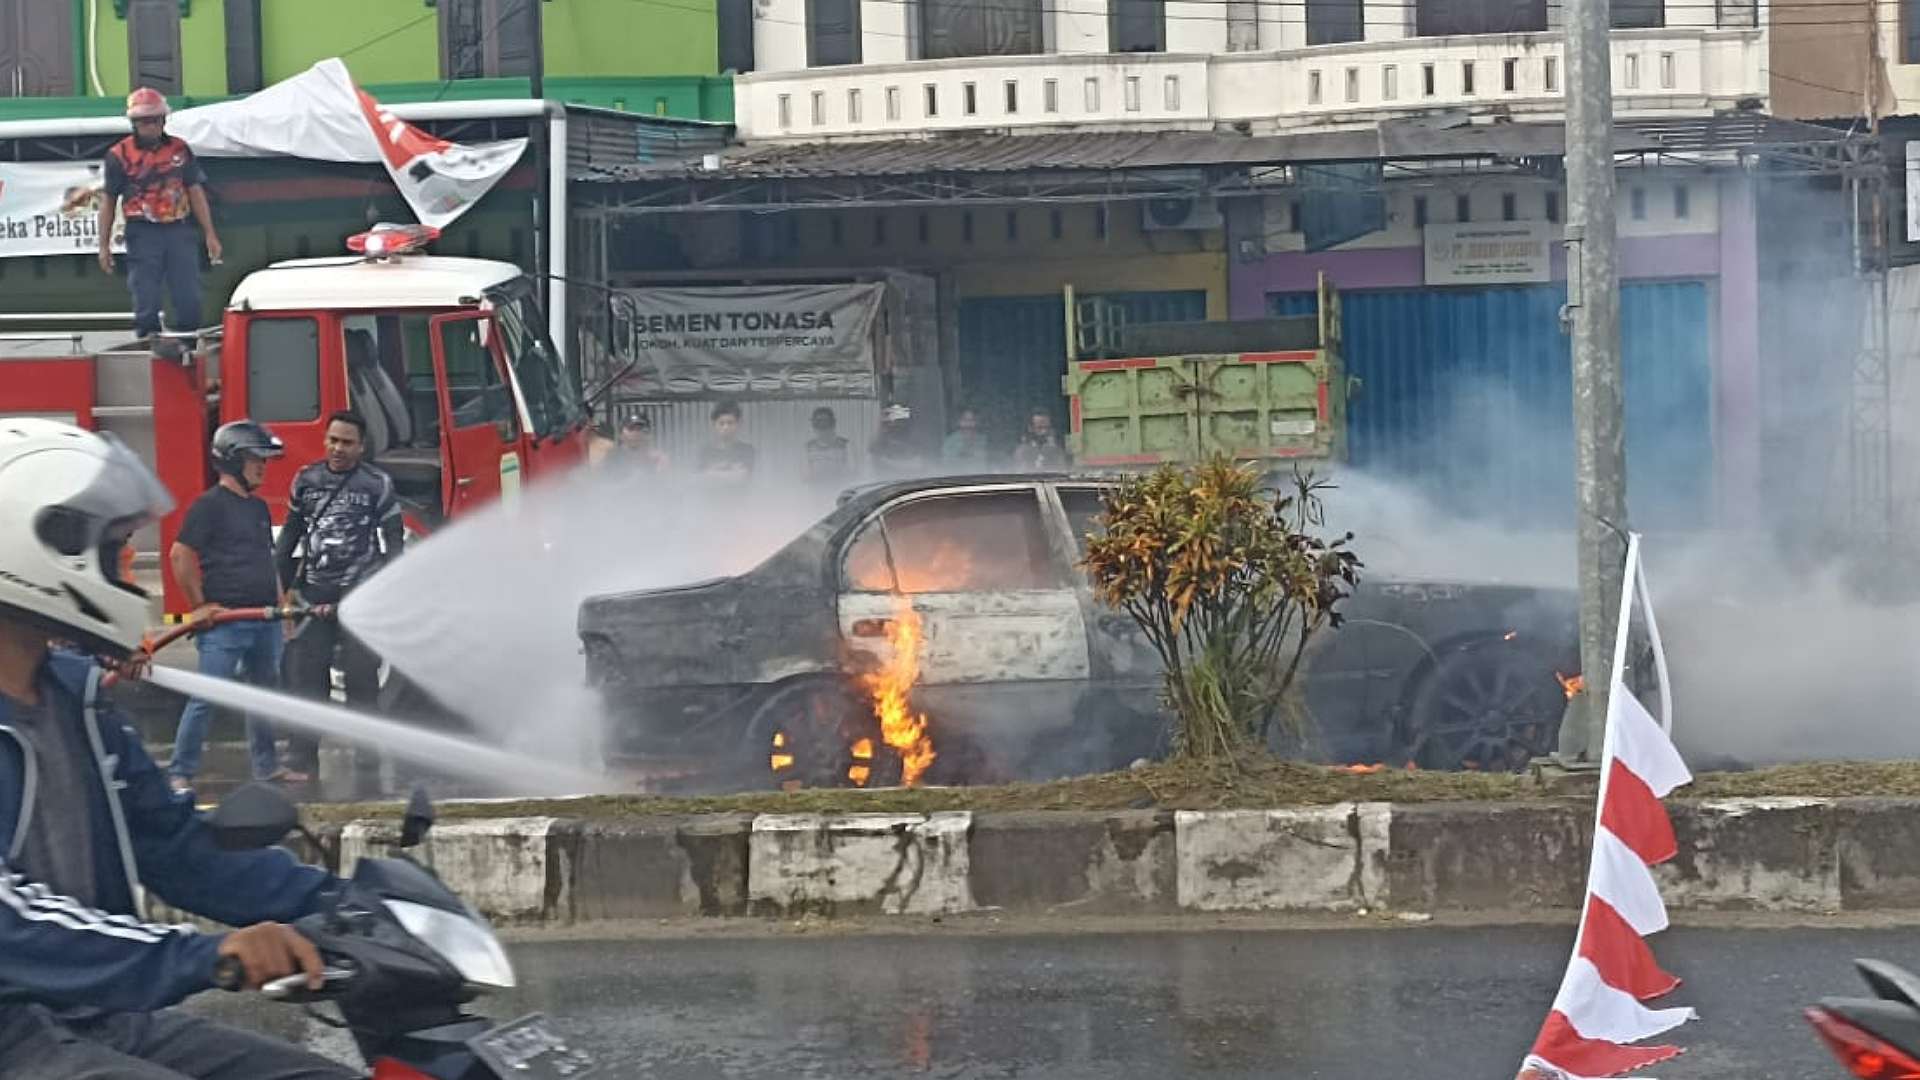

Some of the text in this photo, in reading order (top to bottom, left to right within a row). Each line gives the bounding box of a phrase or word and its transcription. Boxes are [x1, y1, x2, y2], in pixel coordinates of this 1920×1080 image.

[34, 214, 98, 238] Pelasti
[634, 311, 834, 334] SEMEN TONASA
